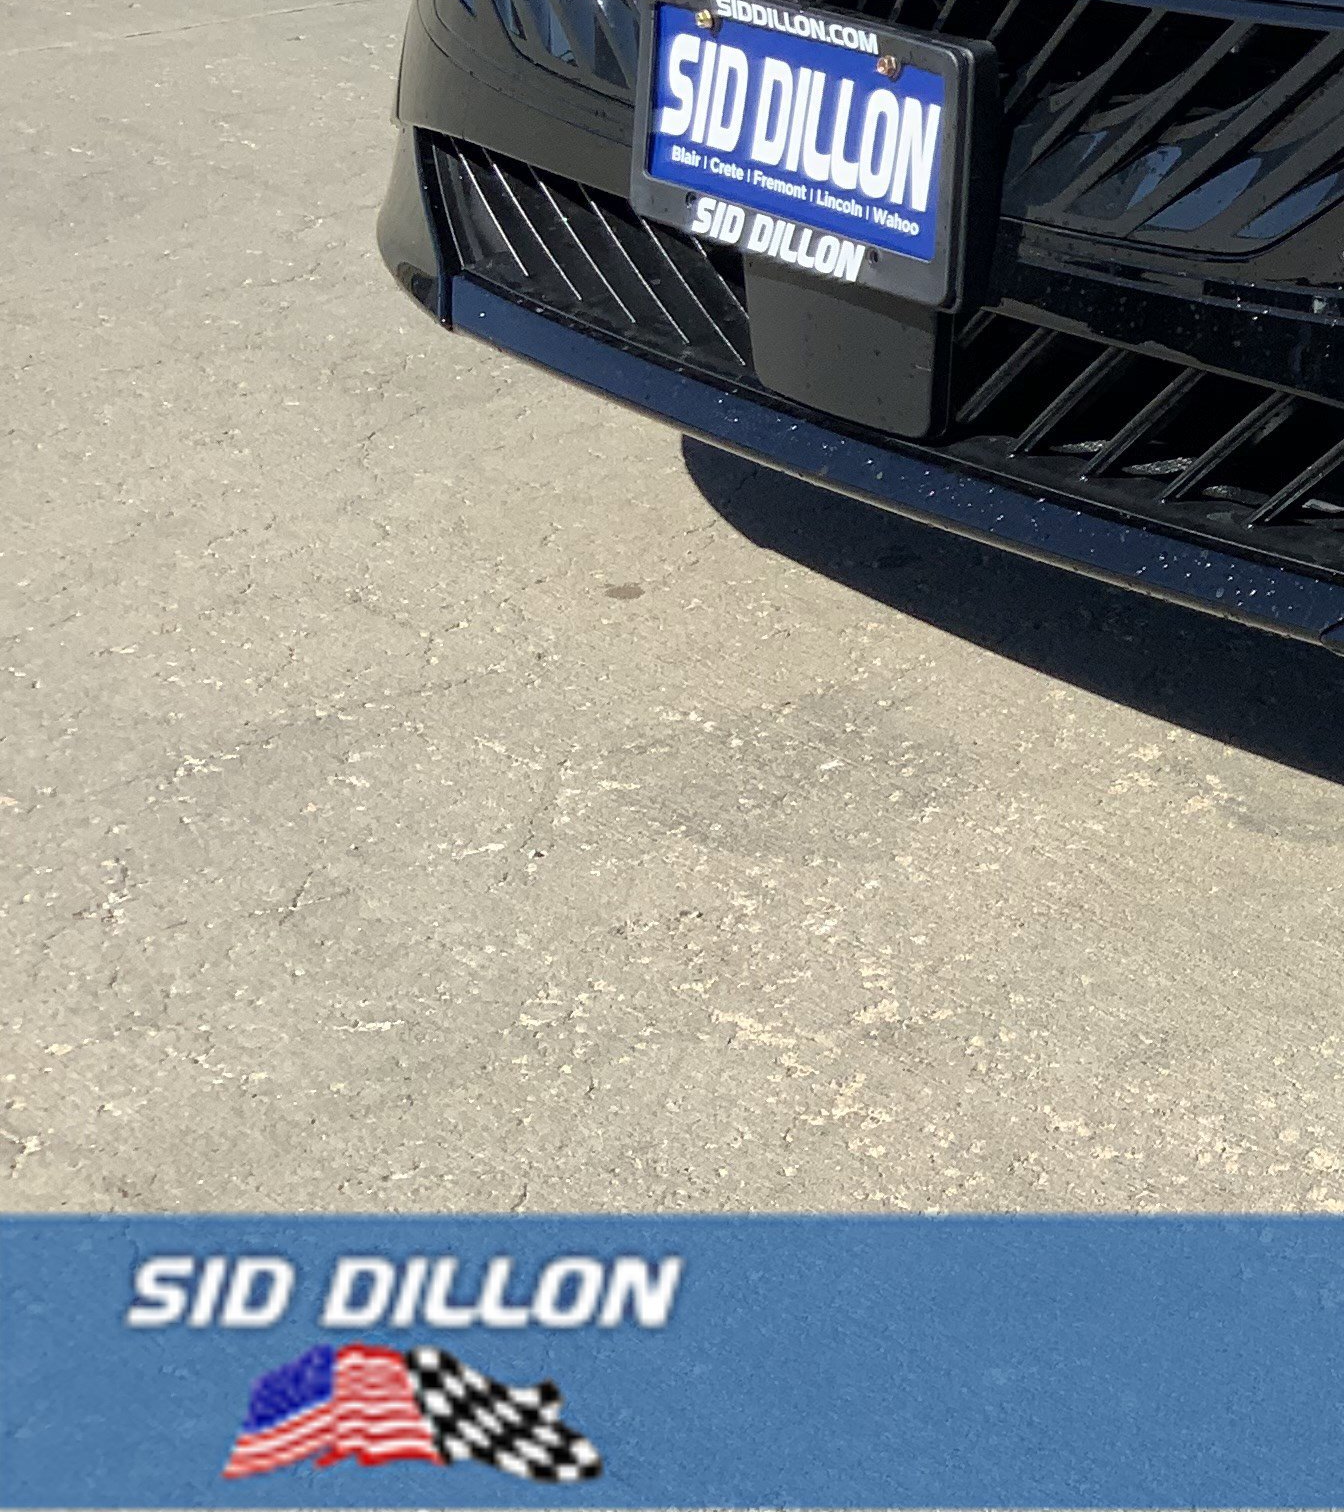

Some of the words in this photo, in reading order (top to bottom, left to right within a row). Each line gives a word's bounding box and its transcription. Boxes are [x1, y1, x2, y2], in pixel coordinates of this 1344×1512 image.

[659, 32, 750, 153] SID
[750, 55, 942, 213] DILLON
[671, 144, 702, 168] Blair
[710, 156, 744, 182] Crete
[753, 172, 808, 203] Fremont
[816, 188, 863, 218] Lincoln
[872, 206, 920, 236] Wahoo
[691, 196, 746, 245] SID
[747, 213, 866, 283] DILLON
